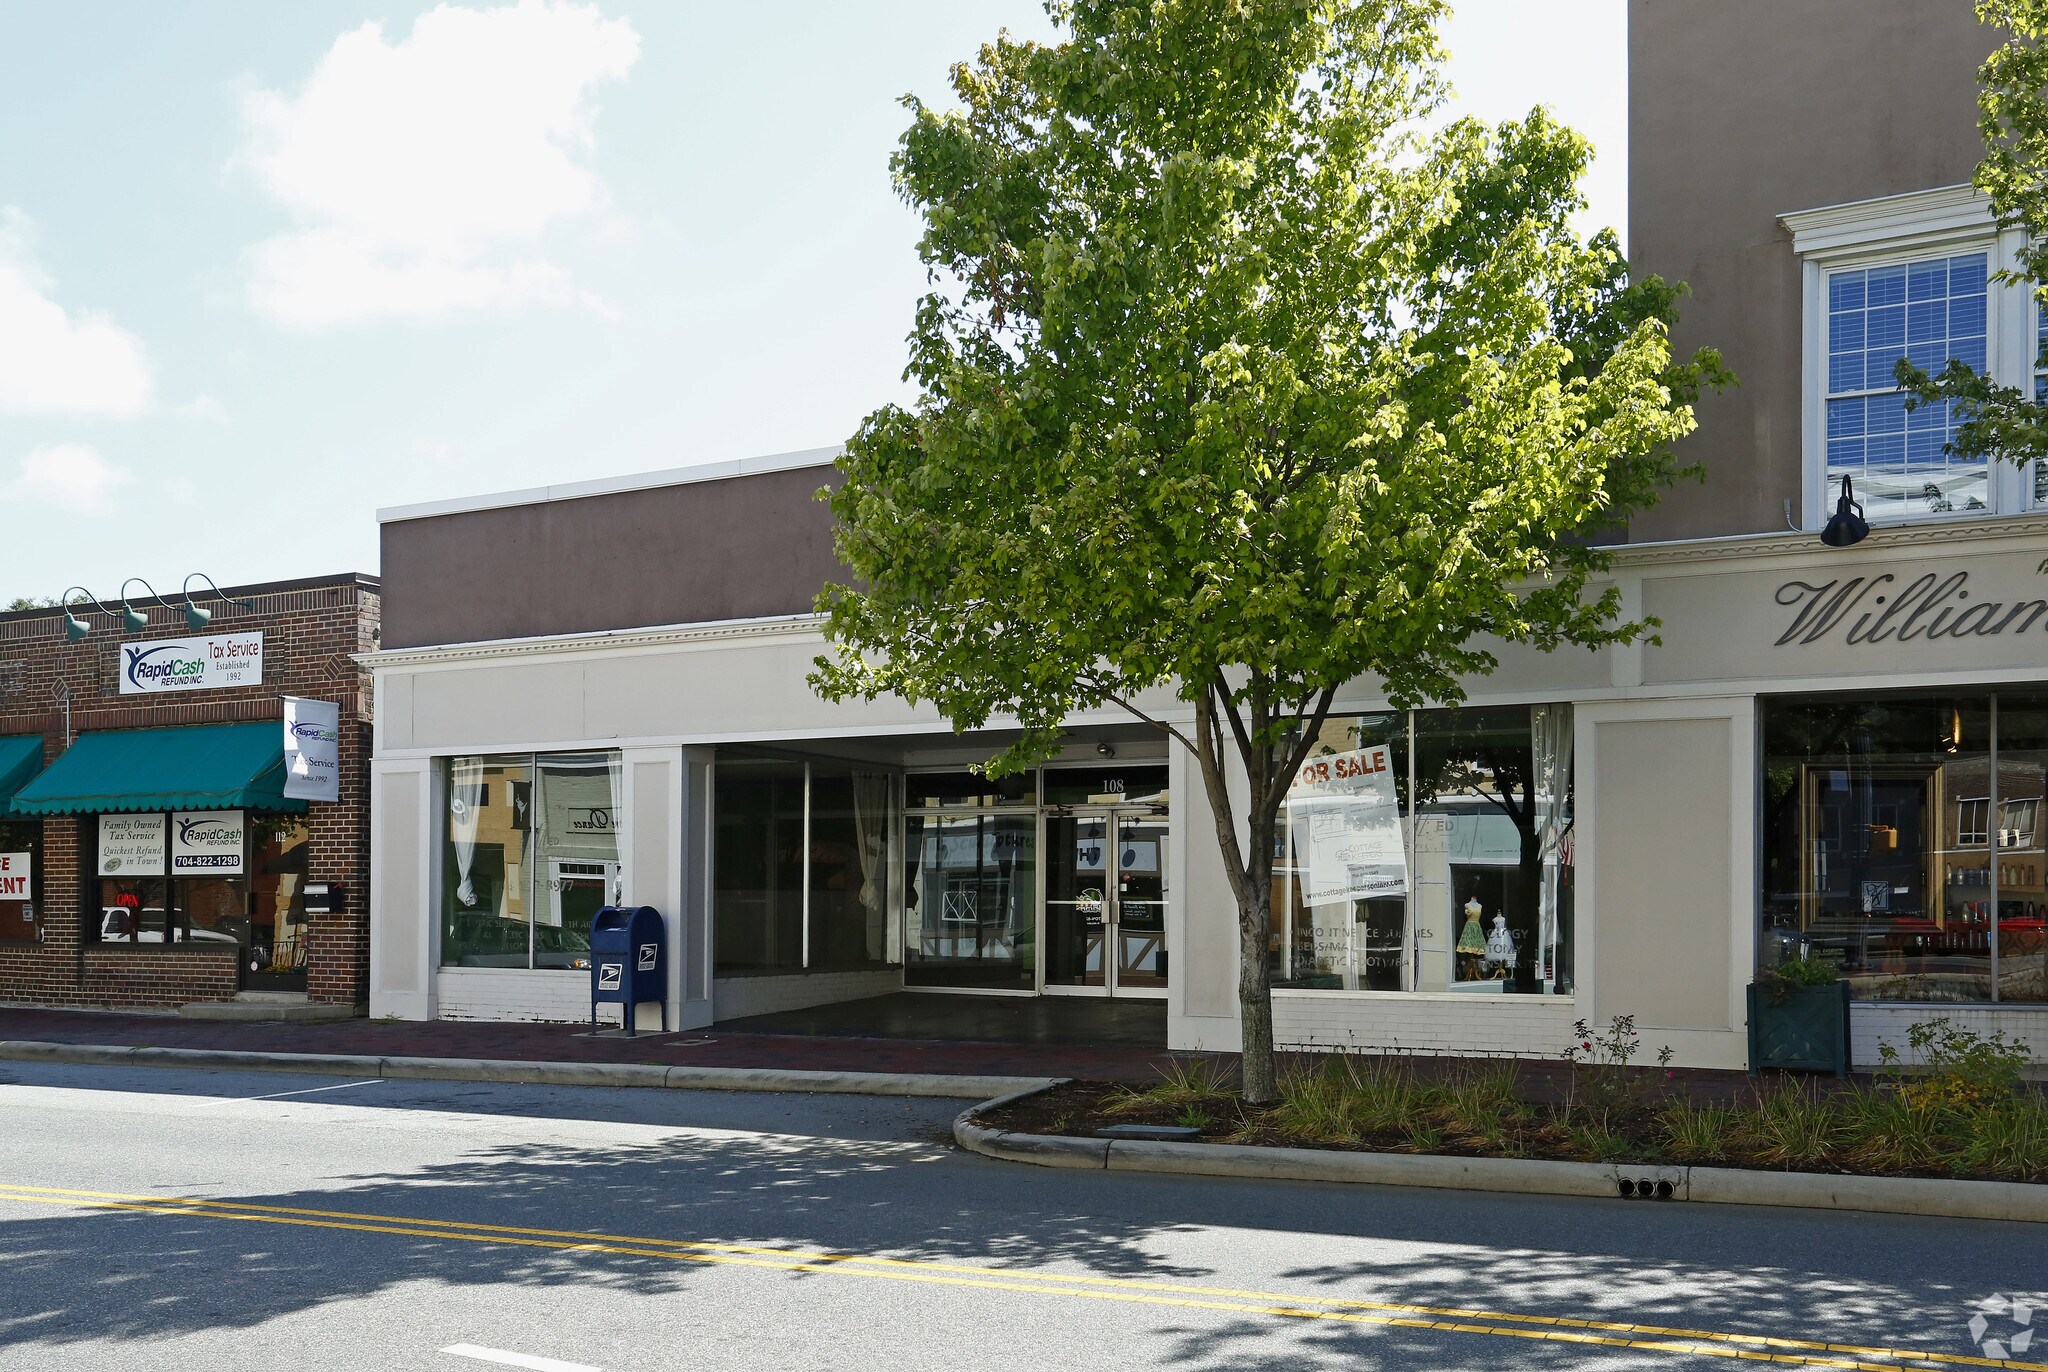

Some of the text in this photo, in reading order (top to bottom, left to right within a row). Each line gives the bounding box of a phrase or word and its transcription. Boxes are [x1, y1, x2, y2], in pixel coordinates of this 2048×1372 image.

[208, 640, 259, 659] Tax Service
[136, 657, 205, 681] RapidCash
[216, 660, 250, 670] Established
[161, 675, 204, 686] REFUND INC.
[226, 671, 241, 681] 1992
[295, 727, 338, 739] RapidCash
[308, 756, 335, 768] Service
[1335, 751, 1387, 779] SALE
[315, 775, 328, 783] 1992
[1102, 779, 1124, 793] 108
[103, 820, 162, 831] Family Owned
[109, 831, 155, 840] Tax Service
[186, 828, 242, 842] RapidCash
[103, 846, 163, 856] Quickest Refund
[1348, 842, 1383, 853] COTTAGE
[126, 857, 134, 865] in
[176, 855, 239, 866] 704-822-1298
[1352, 850, 1384, 861] KEEPERS
[116, 894, 139, 907] OPEN
